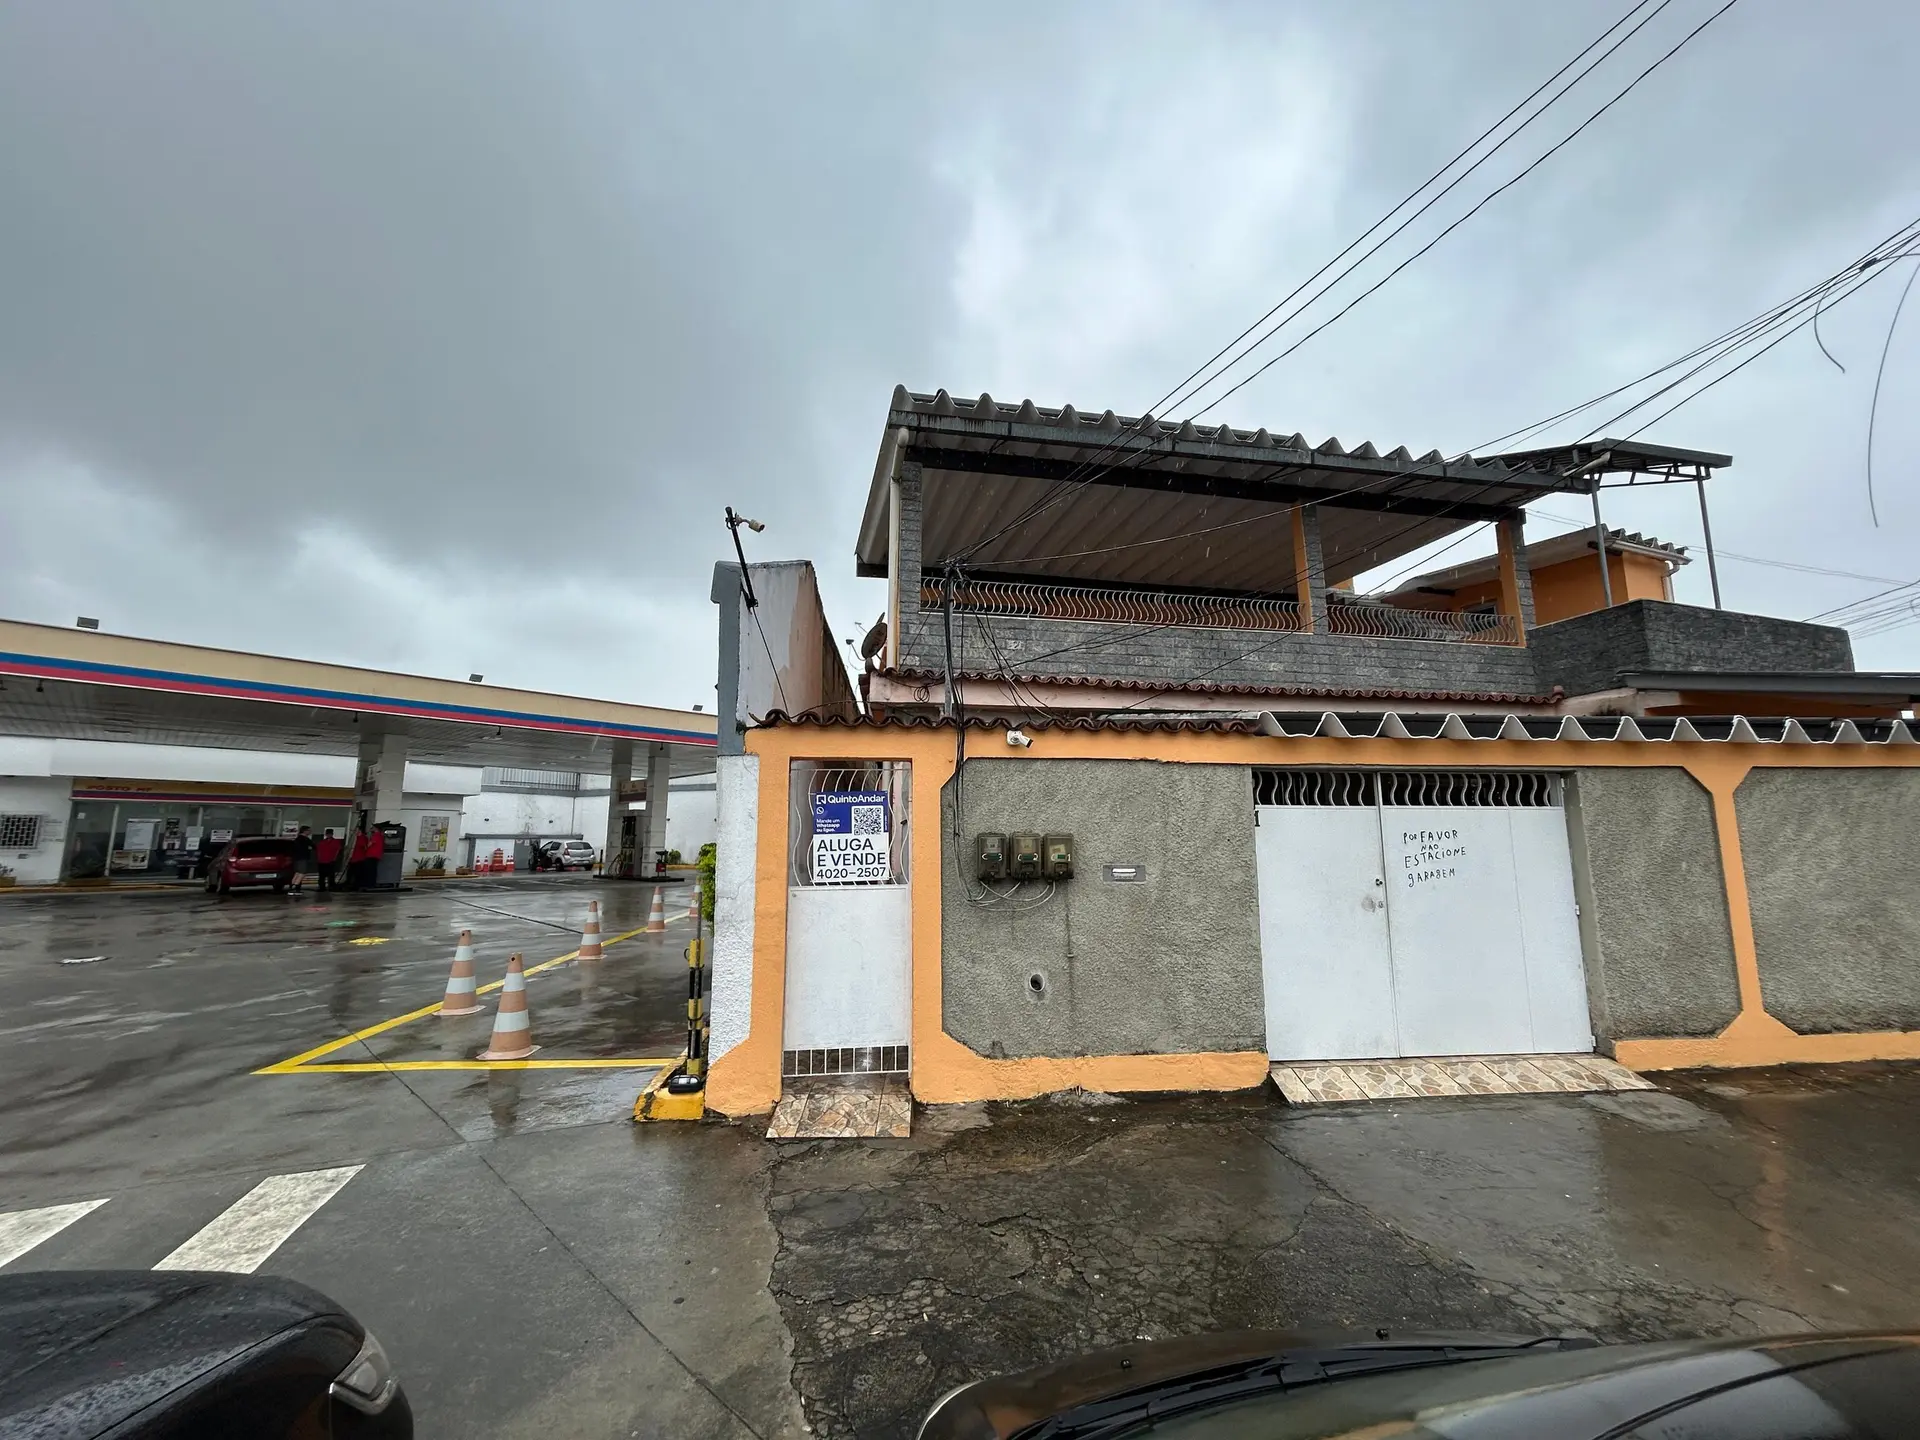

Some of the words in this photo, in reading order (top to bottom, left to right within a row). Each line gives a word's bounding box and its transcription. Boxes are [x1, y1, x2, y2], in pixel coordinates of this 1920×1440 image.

[828, 794, 885, 804] QuintoAndar
[1420, 829, 1458, 843] FAVOR
[817, 838, 874, 852] ALUGA
[817, 854, 826, 867] E
[831, 852, 886, 866] VENDE
[816, 867, 886, 879] 4020-2507
